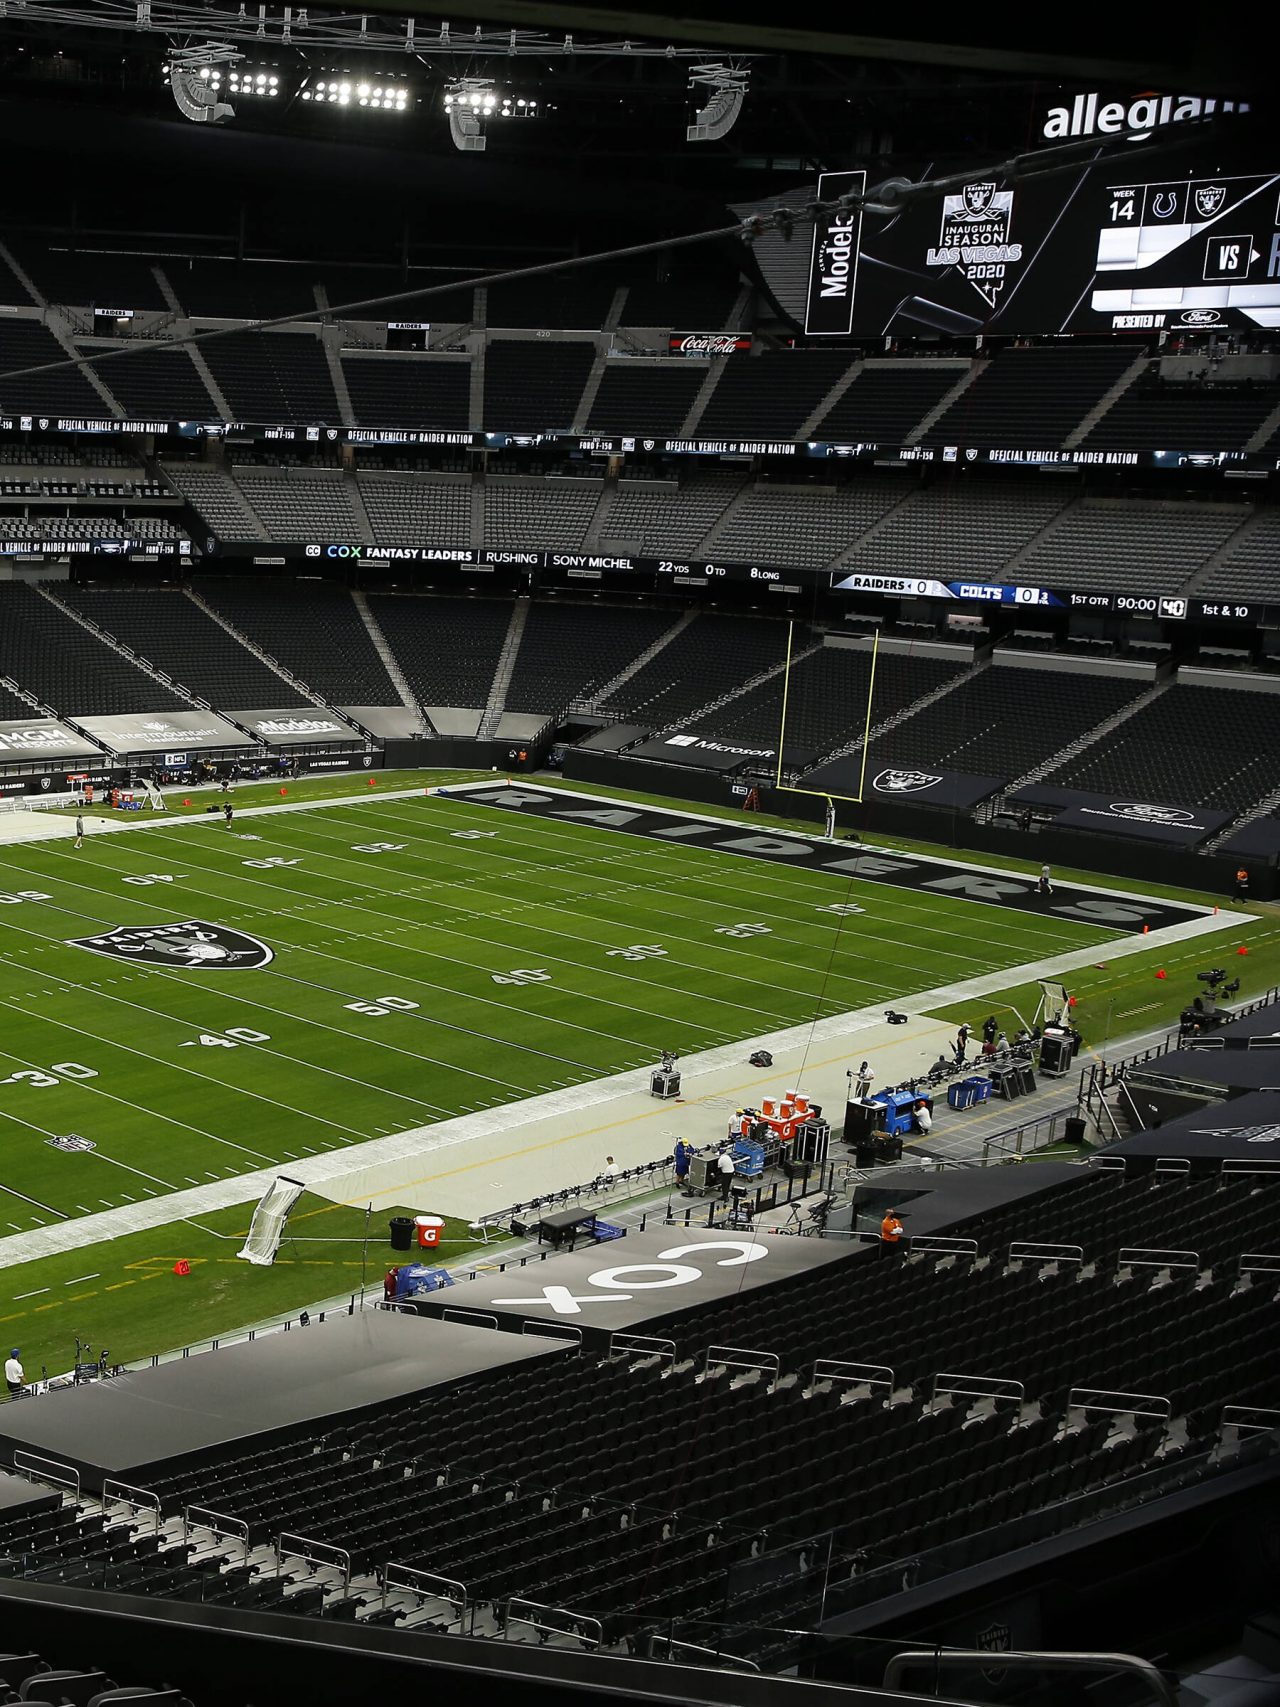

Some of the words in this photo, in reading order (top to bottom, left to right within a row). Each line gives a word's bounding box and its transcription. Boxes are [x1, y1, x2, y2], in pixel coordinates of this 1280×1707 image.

[1043, 93, 1250, 141] allegia
[1113, 189, 1135, 199] WEEK
[1109, 200, 1135, 222] 14
[945, 223, 1004, 235] INAUGURAL
[944, 233, 1004, 246] SEASON
[926, 246, 960, 265] LAS
[962, 244, 1022, 263] VEGAS
[1219, 245, 1240, 270] VS
[967, 264, 1005, 280] 2020
[102, 309, 126, 317] RAIDERS
[1113, 314, 1154, 329] PRESENTED
[1154, 313, 1166, 328] BY
[1188, 311, 1213, 322] Ford
[989, 449, 1024, 462] OFFICIAL
[1026, 450, 1059, 463] VEHICLE
[1062, 453, 1070, 462] OF
[1073, 452, 1104, 464] RAIDER
[1106, 452, 1138, 465] NATION
[307, 546, 320, 556] CC
[327, 546, 361, 558] COX
[366, 548, 419, 560] FANTASY
[422, 549, 472, 561] LEADERS
[486, 552, 538, 565] RUSHING
[553, 554, 586, 567] SONY
[588, 556, 634, 570] MICHEL
[659, 561, 673, 574] 22
[674, 564, 690, 575] YDS
[705, 564, 714, 576] 0
[715, 567, 726, 577] TD
[750, 567, 758, 579] 8
[758, 570, 780, 581] LONG
[854, 577, 905, 591] RAIDERS
[917, 582, 927, 594] 0
[960, 586, 1002, 600] COLTS
[1022, 590, 1032, 602] 0
[1070, 594, 1087, 605] 1ST
[1117, 597, 1156, 611] 90:00
[1162, 600, 1185, 617] 40
[1202, 605, 1220, 616] 1st
[1222, 606, 1231, 616] &
[1234, 606, 1248, 618] 10
[113, 729, 219, 740] Intermountain
[11, 738, 78, 749] RESORTS
[695, 740, 775, 758] Microsoft
[890, 771, 933, 782] RAIDERS
[1124, 804, 1179, 819] Ford
[350, 842, 404, 854] 20
[464, 789, 1164, 922] RAIDERS
[241, 857, 298, 869] 30
[121, 873, 176, 885] 40
[88, 923, 200, 946] RAIDERS
[714, 923, 773, 938] 20
[605, 944, 669, 961] 30
[491, 969, 553, 986] 40
[342, 996, 421, 1017] 50
[199, 1027, 272, 1048] 40
[11, 1062, 100, 1088] 30
[782, 1123, 791, 1137] G
[424, 1229, 436, 1242] G
[490, 1241, 769, 1315] COX
